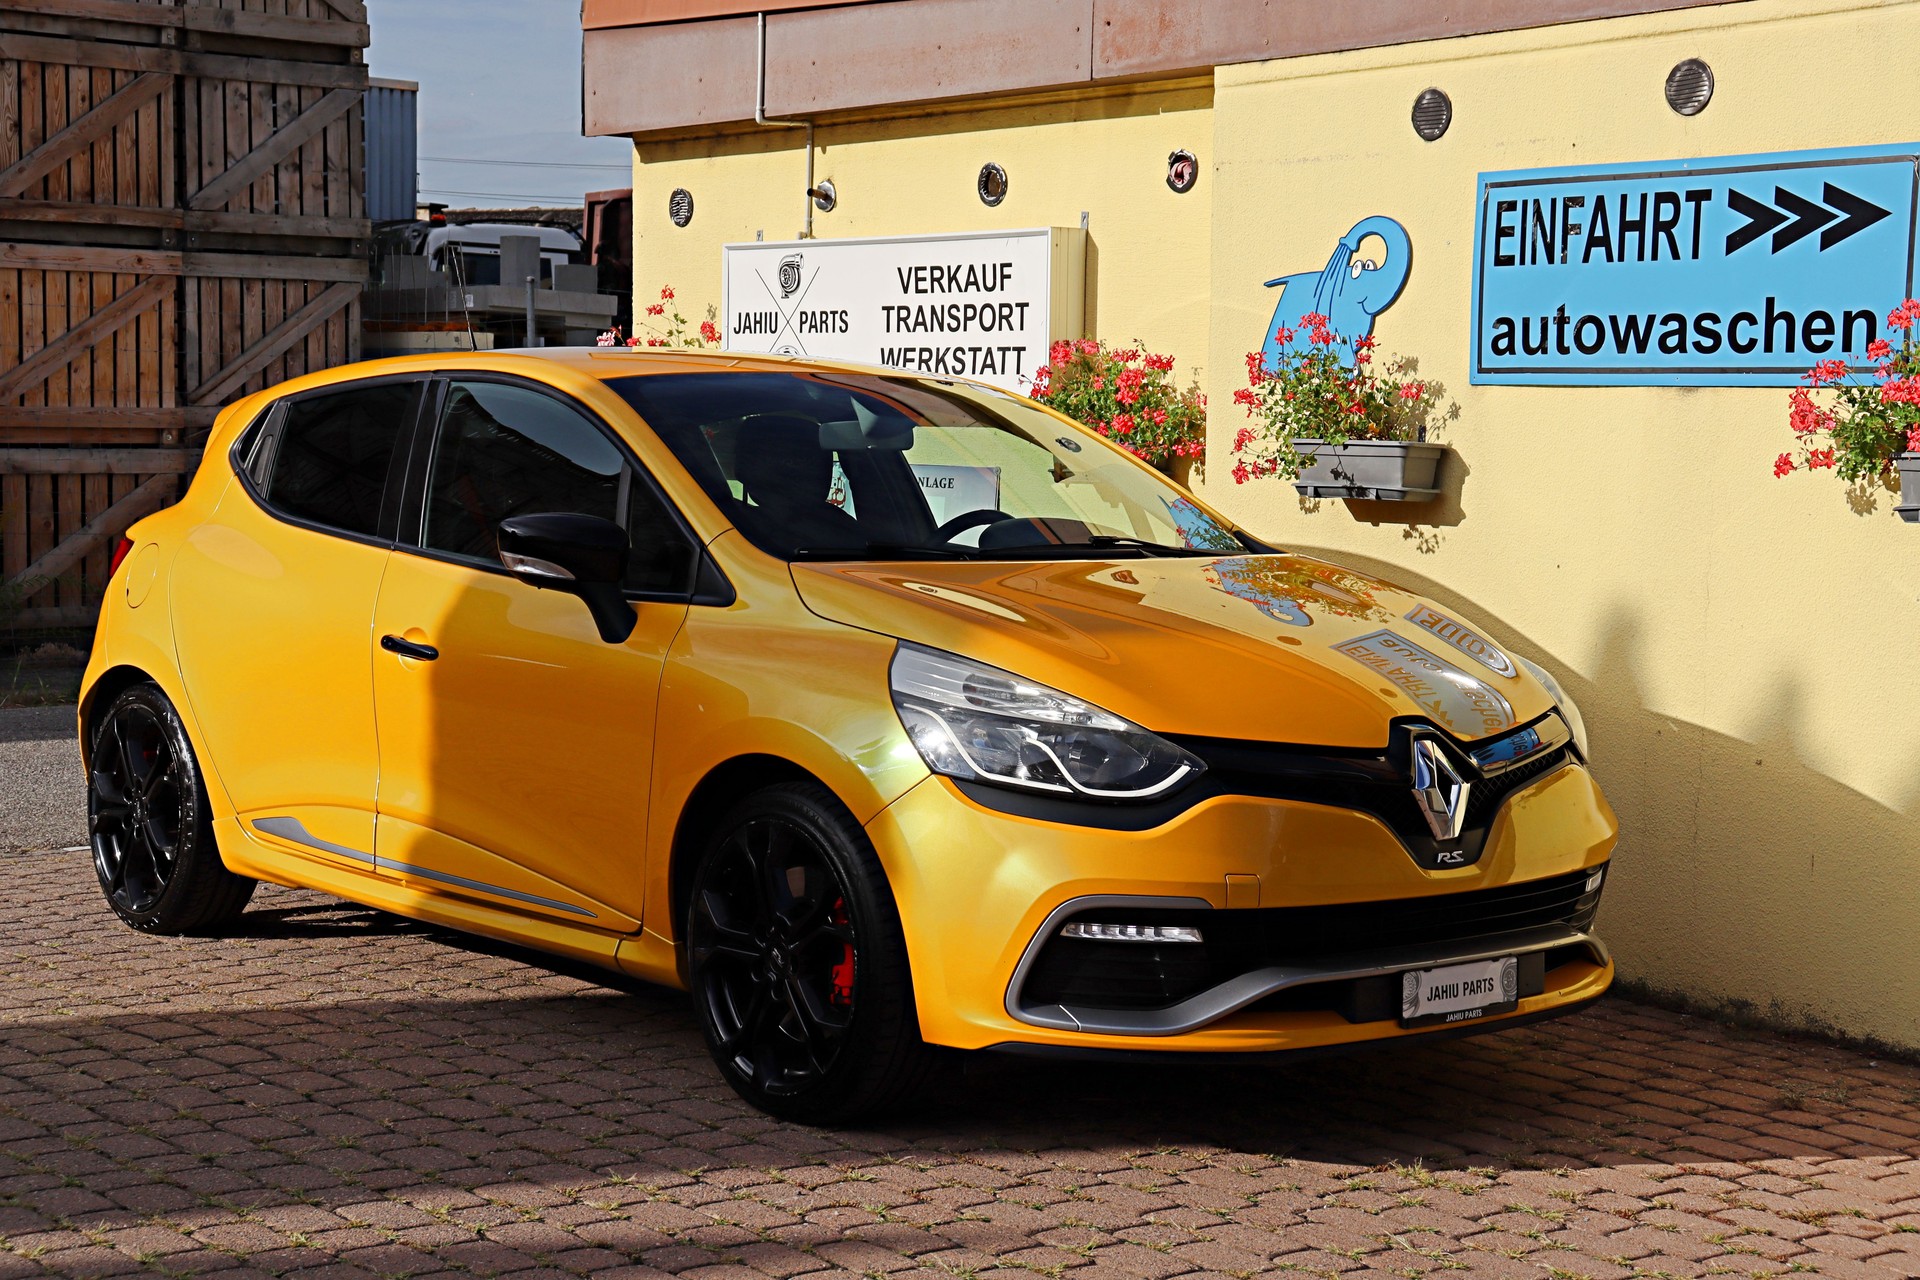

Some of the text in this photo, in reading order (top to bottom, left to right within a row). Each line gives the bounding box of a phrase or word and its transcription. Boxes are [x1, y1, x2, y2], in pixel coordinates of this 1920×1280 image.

[1493, 188, 1713, 267] EINFAHRT
[897, 262, 1013, 295] VERKAUF
[733, 310, 849, 335] JAHIU PARTS
[881, 302, 1030, 333] TRANSPORT
[1490, 296, 1878, 357] autowaschen
[881, 346, 1027, 376] WERKSTATT
[1436, 850, 1465, 864] RS
[1426, 977, 1495, 1002] JAHIU PARTS
[1445, 1008, 1483, 1023] JAHIU PARTS
